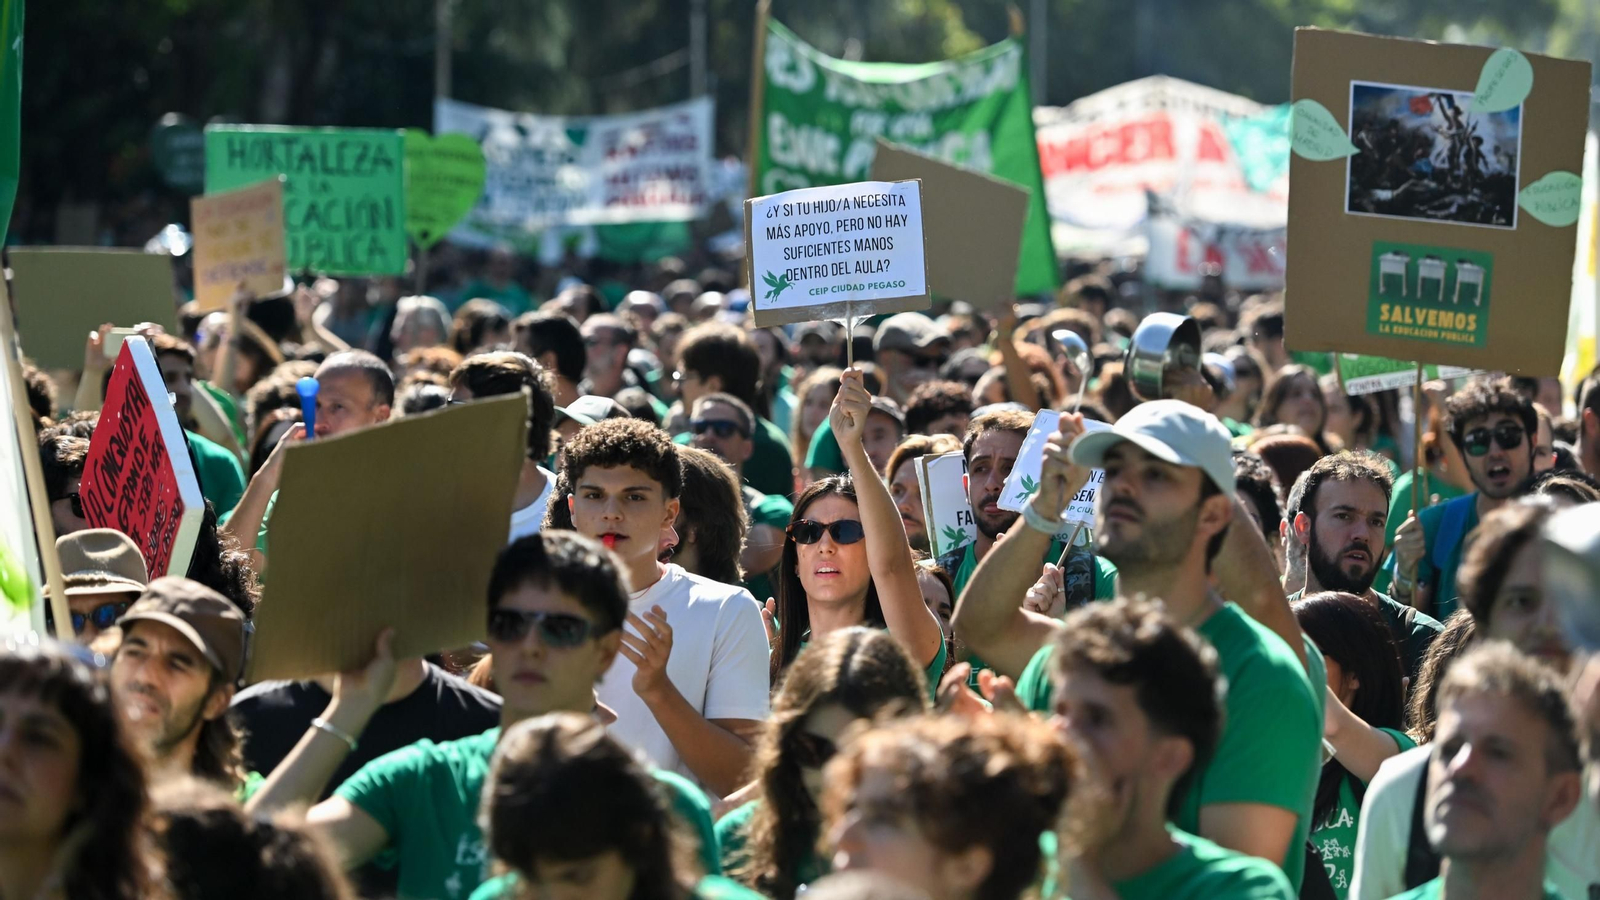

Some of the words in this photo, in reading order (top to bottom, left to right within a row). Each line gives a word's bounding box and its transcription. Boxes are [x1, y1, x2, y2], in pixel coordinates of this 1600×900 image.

[227, 136, 395, 177] HORTALEZA
[284, 193, 396, 232] CACIÓN
[766, 204, 780, 219] ¿Y
[783, 203, 794, 216] SI
[798, 202, 811, 216] TU
[813, 197, 851, 214] HIJO/A
[853, 194, 906, 209] NECESITA
[766, 223, 791, 240] MÁS
[794, 221, 834, 238] APOYO,
[836, 217, 864, 233] PERO
[867, 215, 882, 229] NO
[885, 214, 908, 228] HAY
[783, 239, 851, 261] SUFICIENTES
[854, 236, 894, 252] MANOS
[785, 264, 828, 282] DENTRO
[831, 261, 851, 277] DEL
[854, 258, 891, 274] AULA?
[808, 287, 829, 296] CEIP
[831, 283, 865, 293] CIUDAD
[868, 280, 906, 290] PEGASO
[1379, 323, 1390, 333] LA
[1380, 303, 1477, 332] SALVEMOS
[117, 424, 149, 534] GRANDE
[1073, 488, 1095, 503] SEÑ
[957, 510, 977, 526] FA
